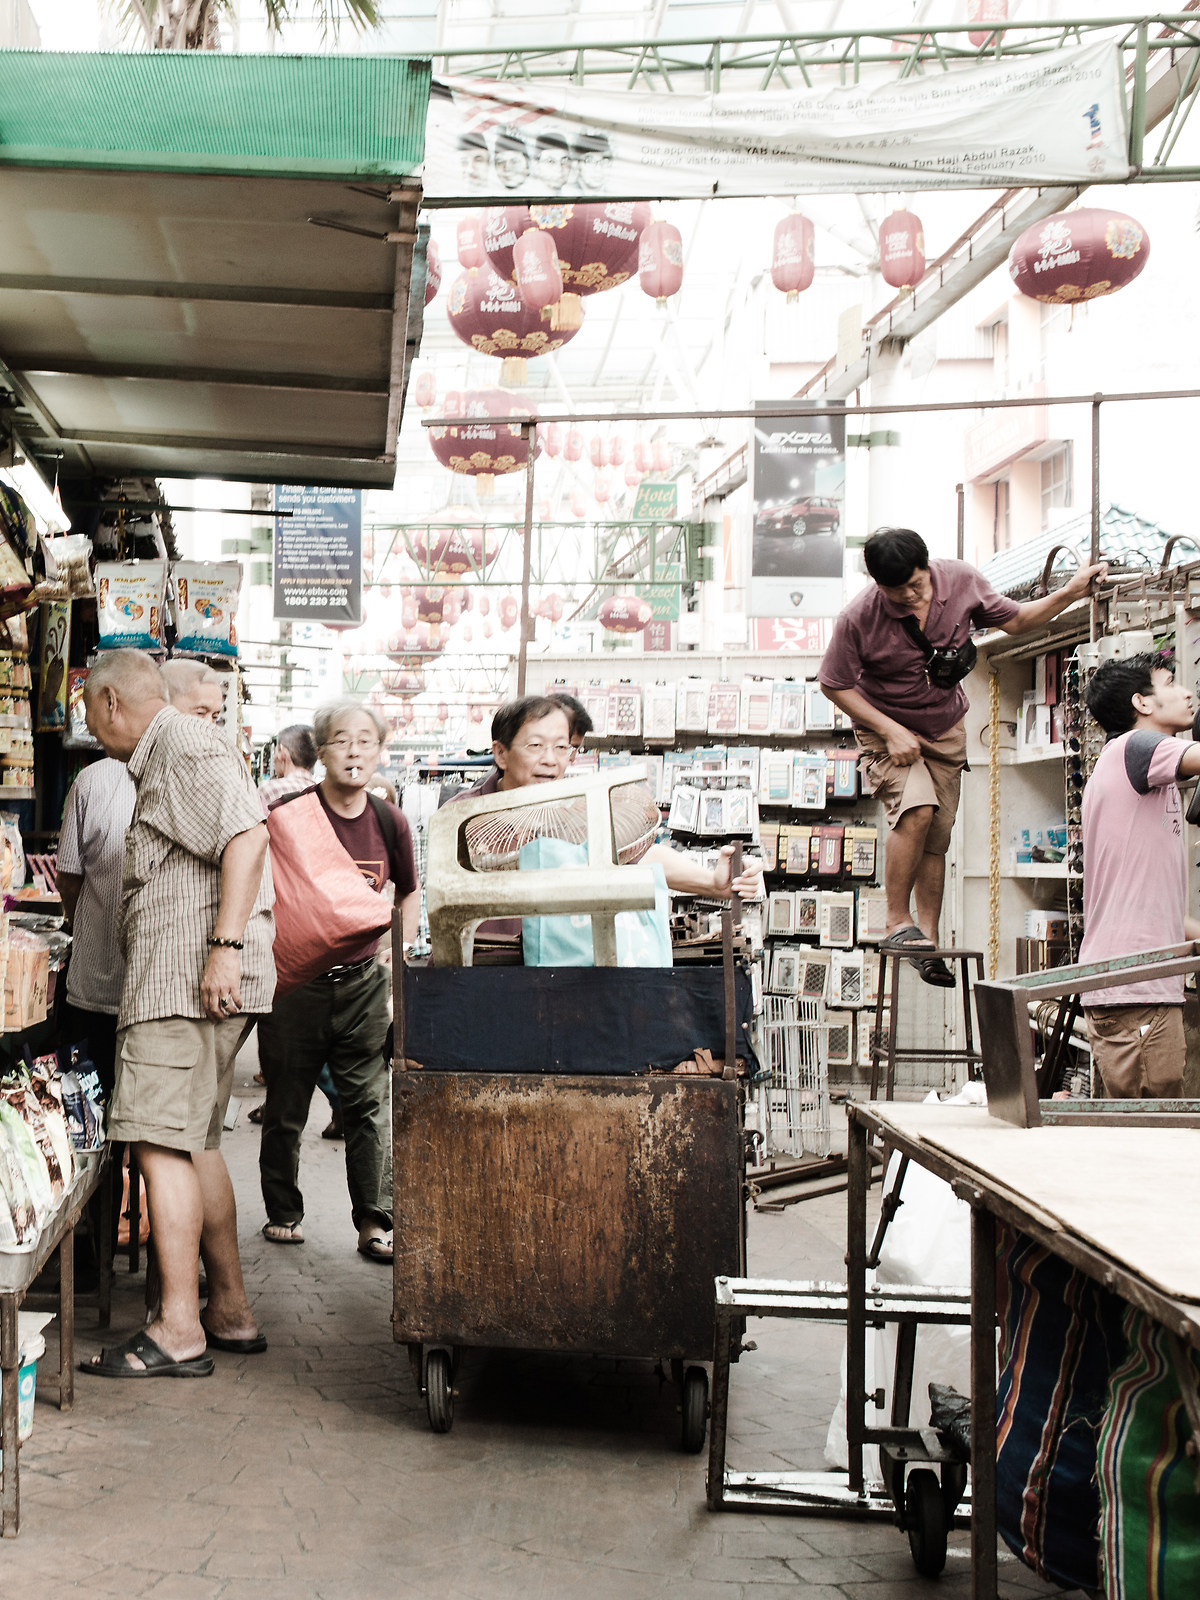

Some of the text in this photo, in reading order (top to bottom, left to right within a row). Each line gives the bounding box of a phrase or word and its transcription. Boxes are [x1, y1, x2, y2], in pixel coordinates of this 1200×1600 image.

[1074, 68, 1102, 82] 2010
[641, 145, 660, 155] Our
[912, 158, 934, 169] Tun
[937, 155, 960, 167] Haji
[962, 149, 997, 163] Abdul
[966, 158, 1016, 173] February
[1018, 153, 1046, 166] 2010
[302, 495, 316, 505] you
[317, 494, 356, 504] customers
[639, 488, 676, 502] Hotel
[283, 586, 348, 596] www.ebbx.com
[284, 596, 308, 606] 1800
[309, 596, 328, 606] 220
